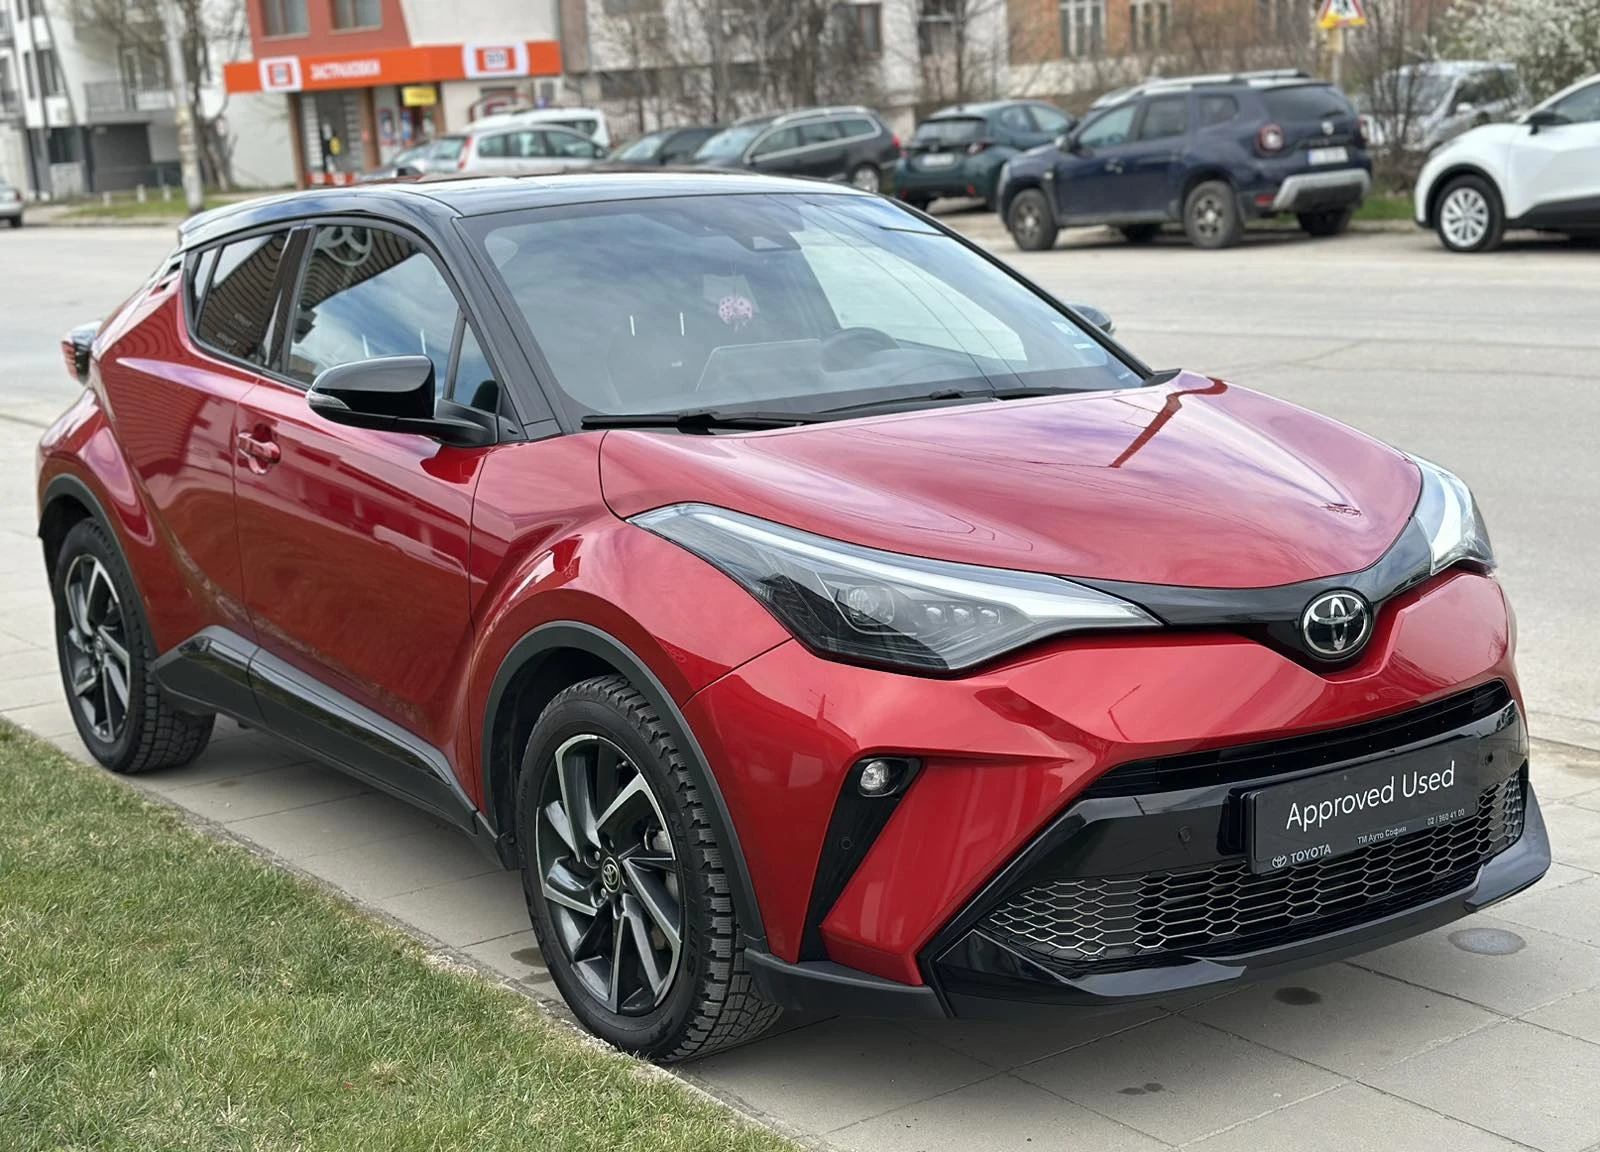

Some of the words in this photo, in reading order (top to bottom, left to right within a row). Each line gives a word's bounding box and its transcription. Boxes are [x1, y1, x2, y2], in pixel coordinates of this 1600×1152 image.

[1286, 776, 1395, 832] Approved
[1402, 760, 1455, 798] Used
[1290, 844, 1331, 863] TOYOTA
